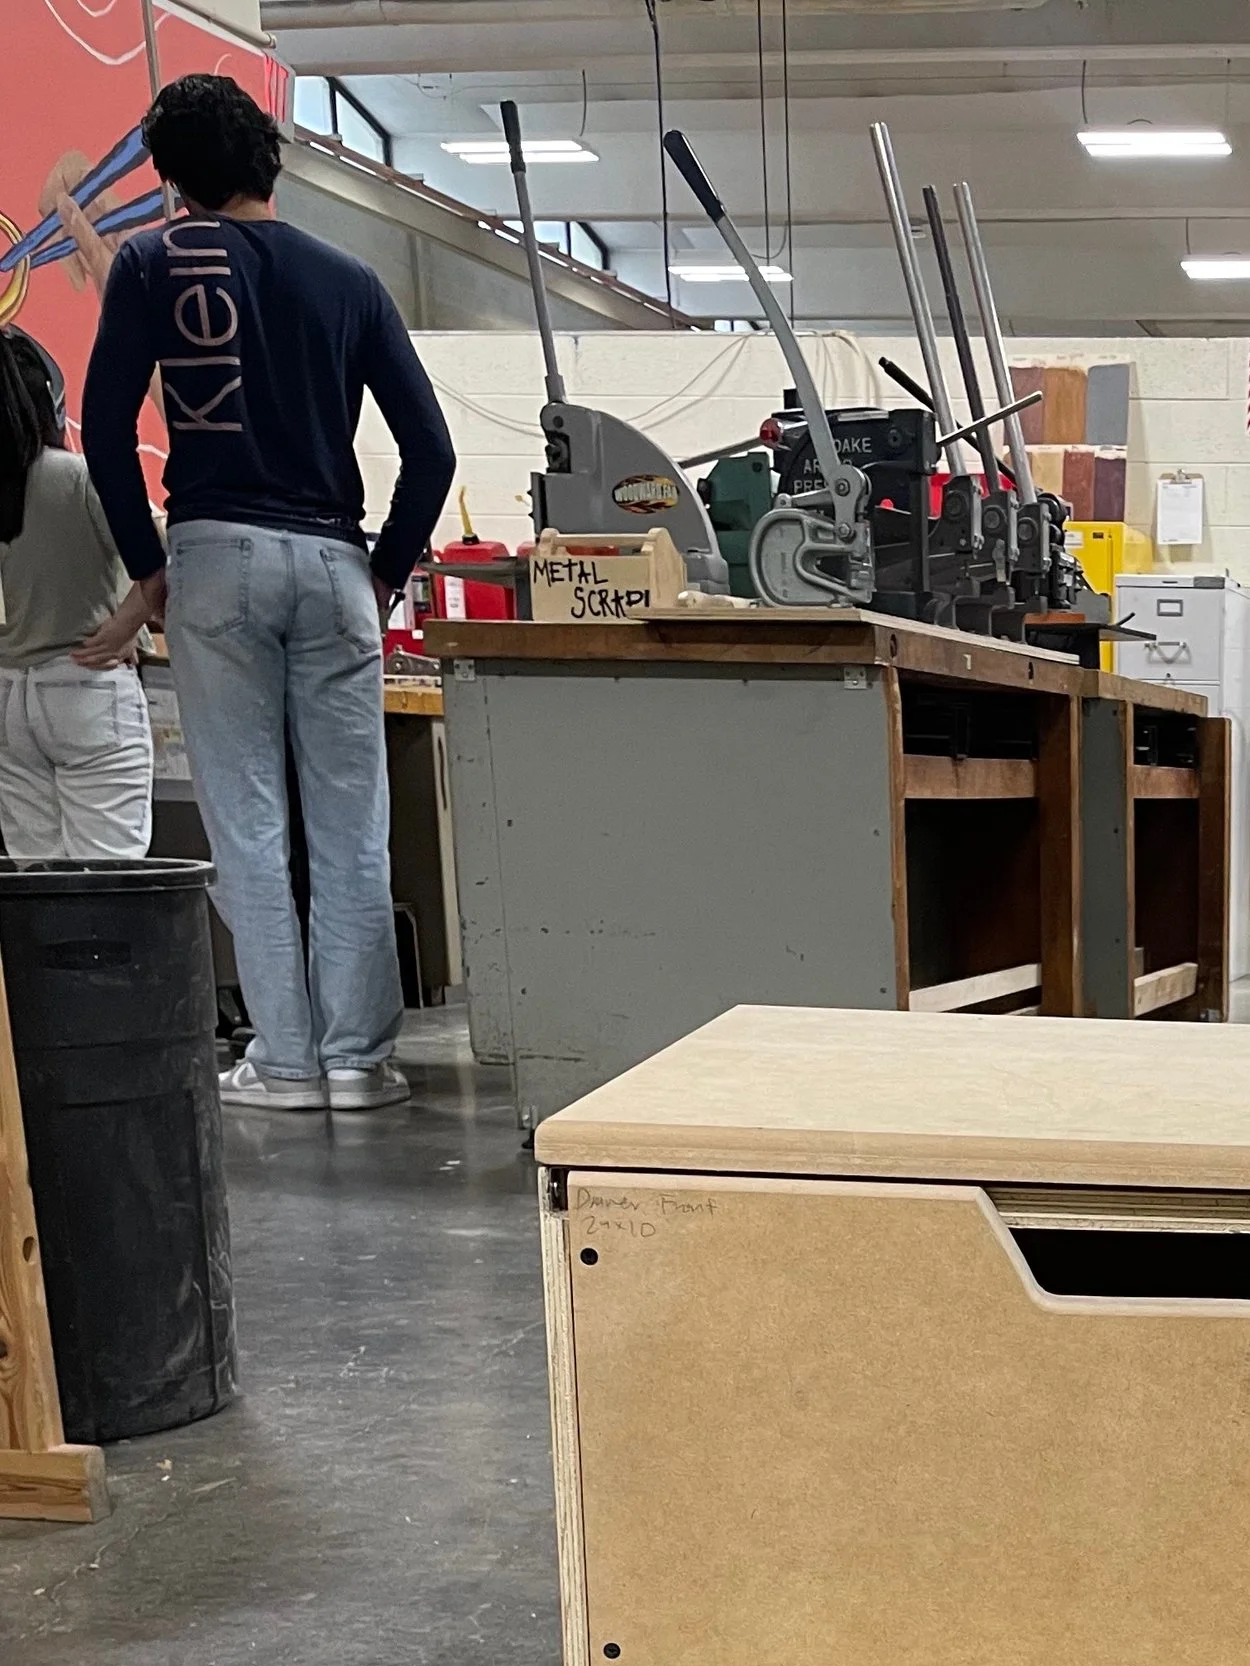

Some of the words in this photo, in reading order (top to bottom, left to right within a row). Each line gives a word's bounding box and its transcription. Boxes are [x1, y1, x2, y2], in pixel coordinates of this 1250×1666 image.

[264, 54, 289, 124] XIT
[163, 221, 243, 432] Klein
[833, 437, 873, 454] DAKE
[793, 479, 830, 495] PRE
[533, 558, 609, 588] METAL
